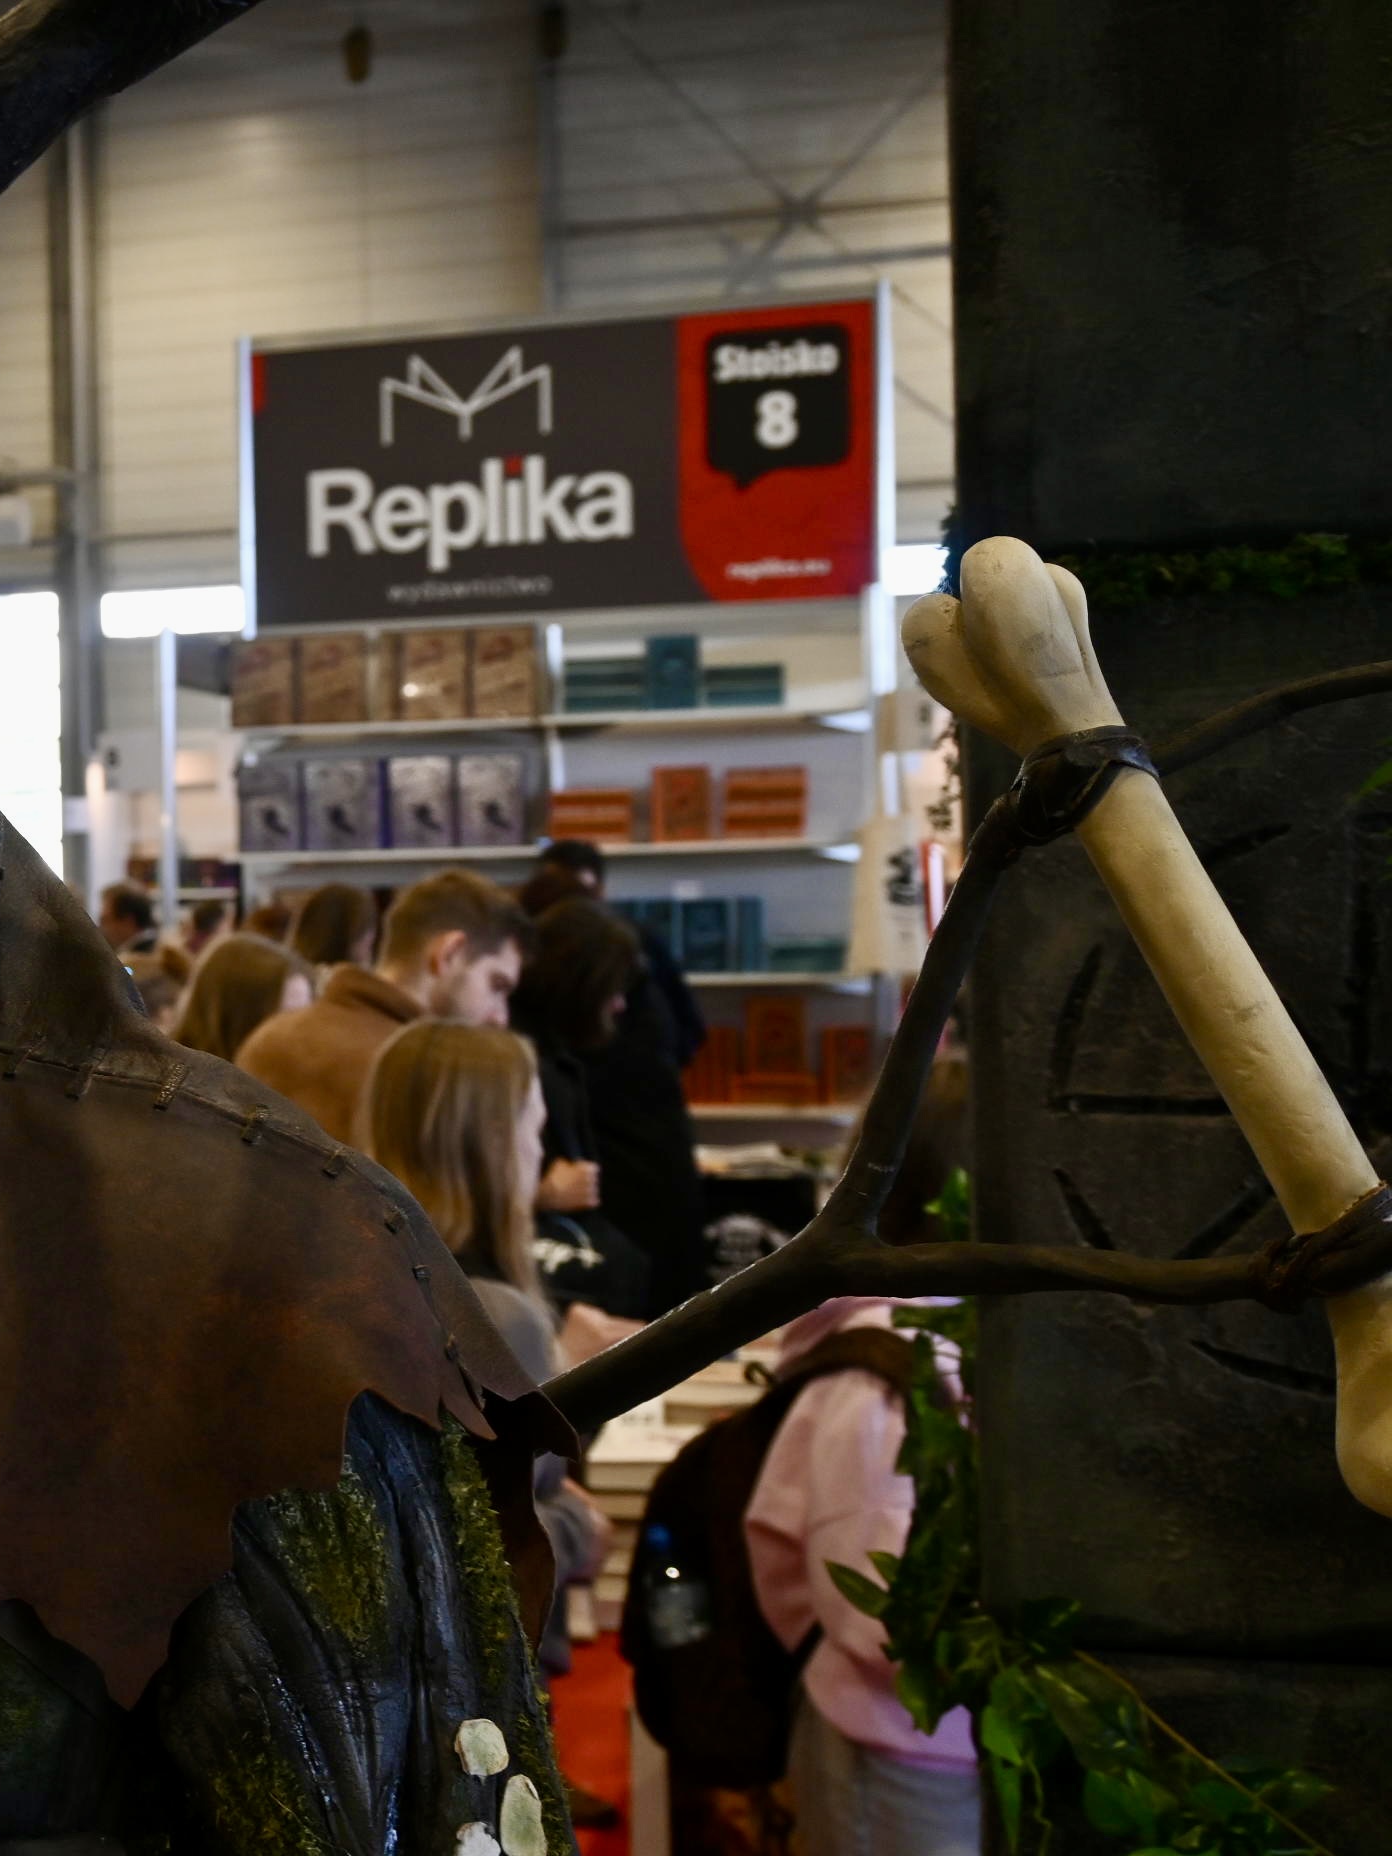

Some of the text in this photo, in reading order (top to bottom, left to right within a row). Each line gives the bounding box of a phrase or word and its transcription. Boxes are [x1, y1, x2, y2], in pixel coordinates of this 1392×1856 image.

[715, 340, 839, 383] Stoisko
[757, 390, 798, 449] 8
[307, 455, 633, 571] Replika
